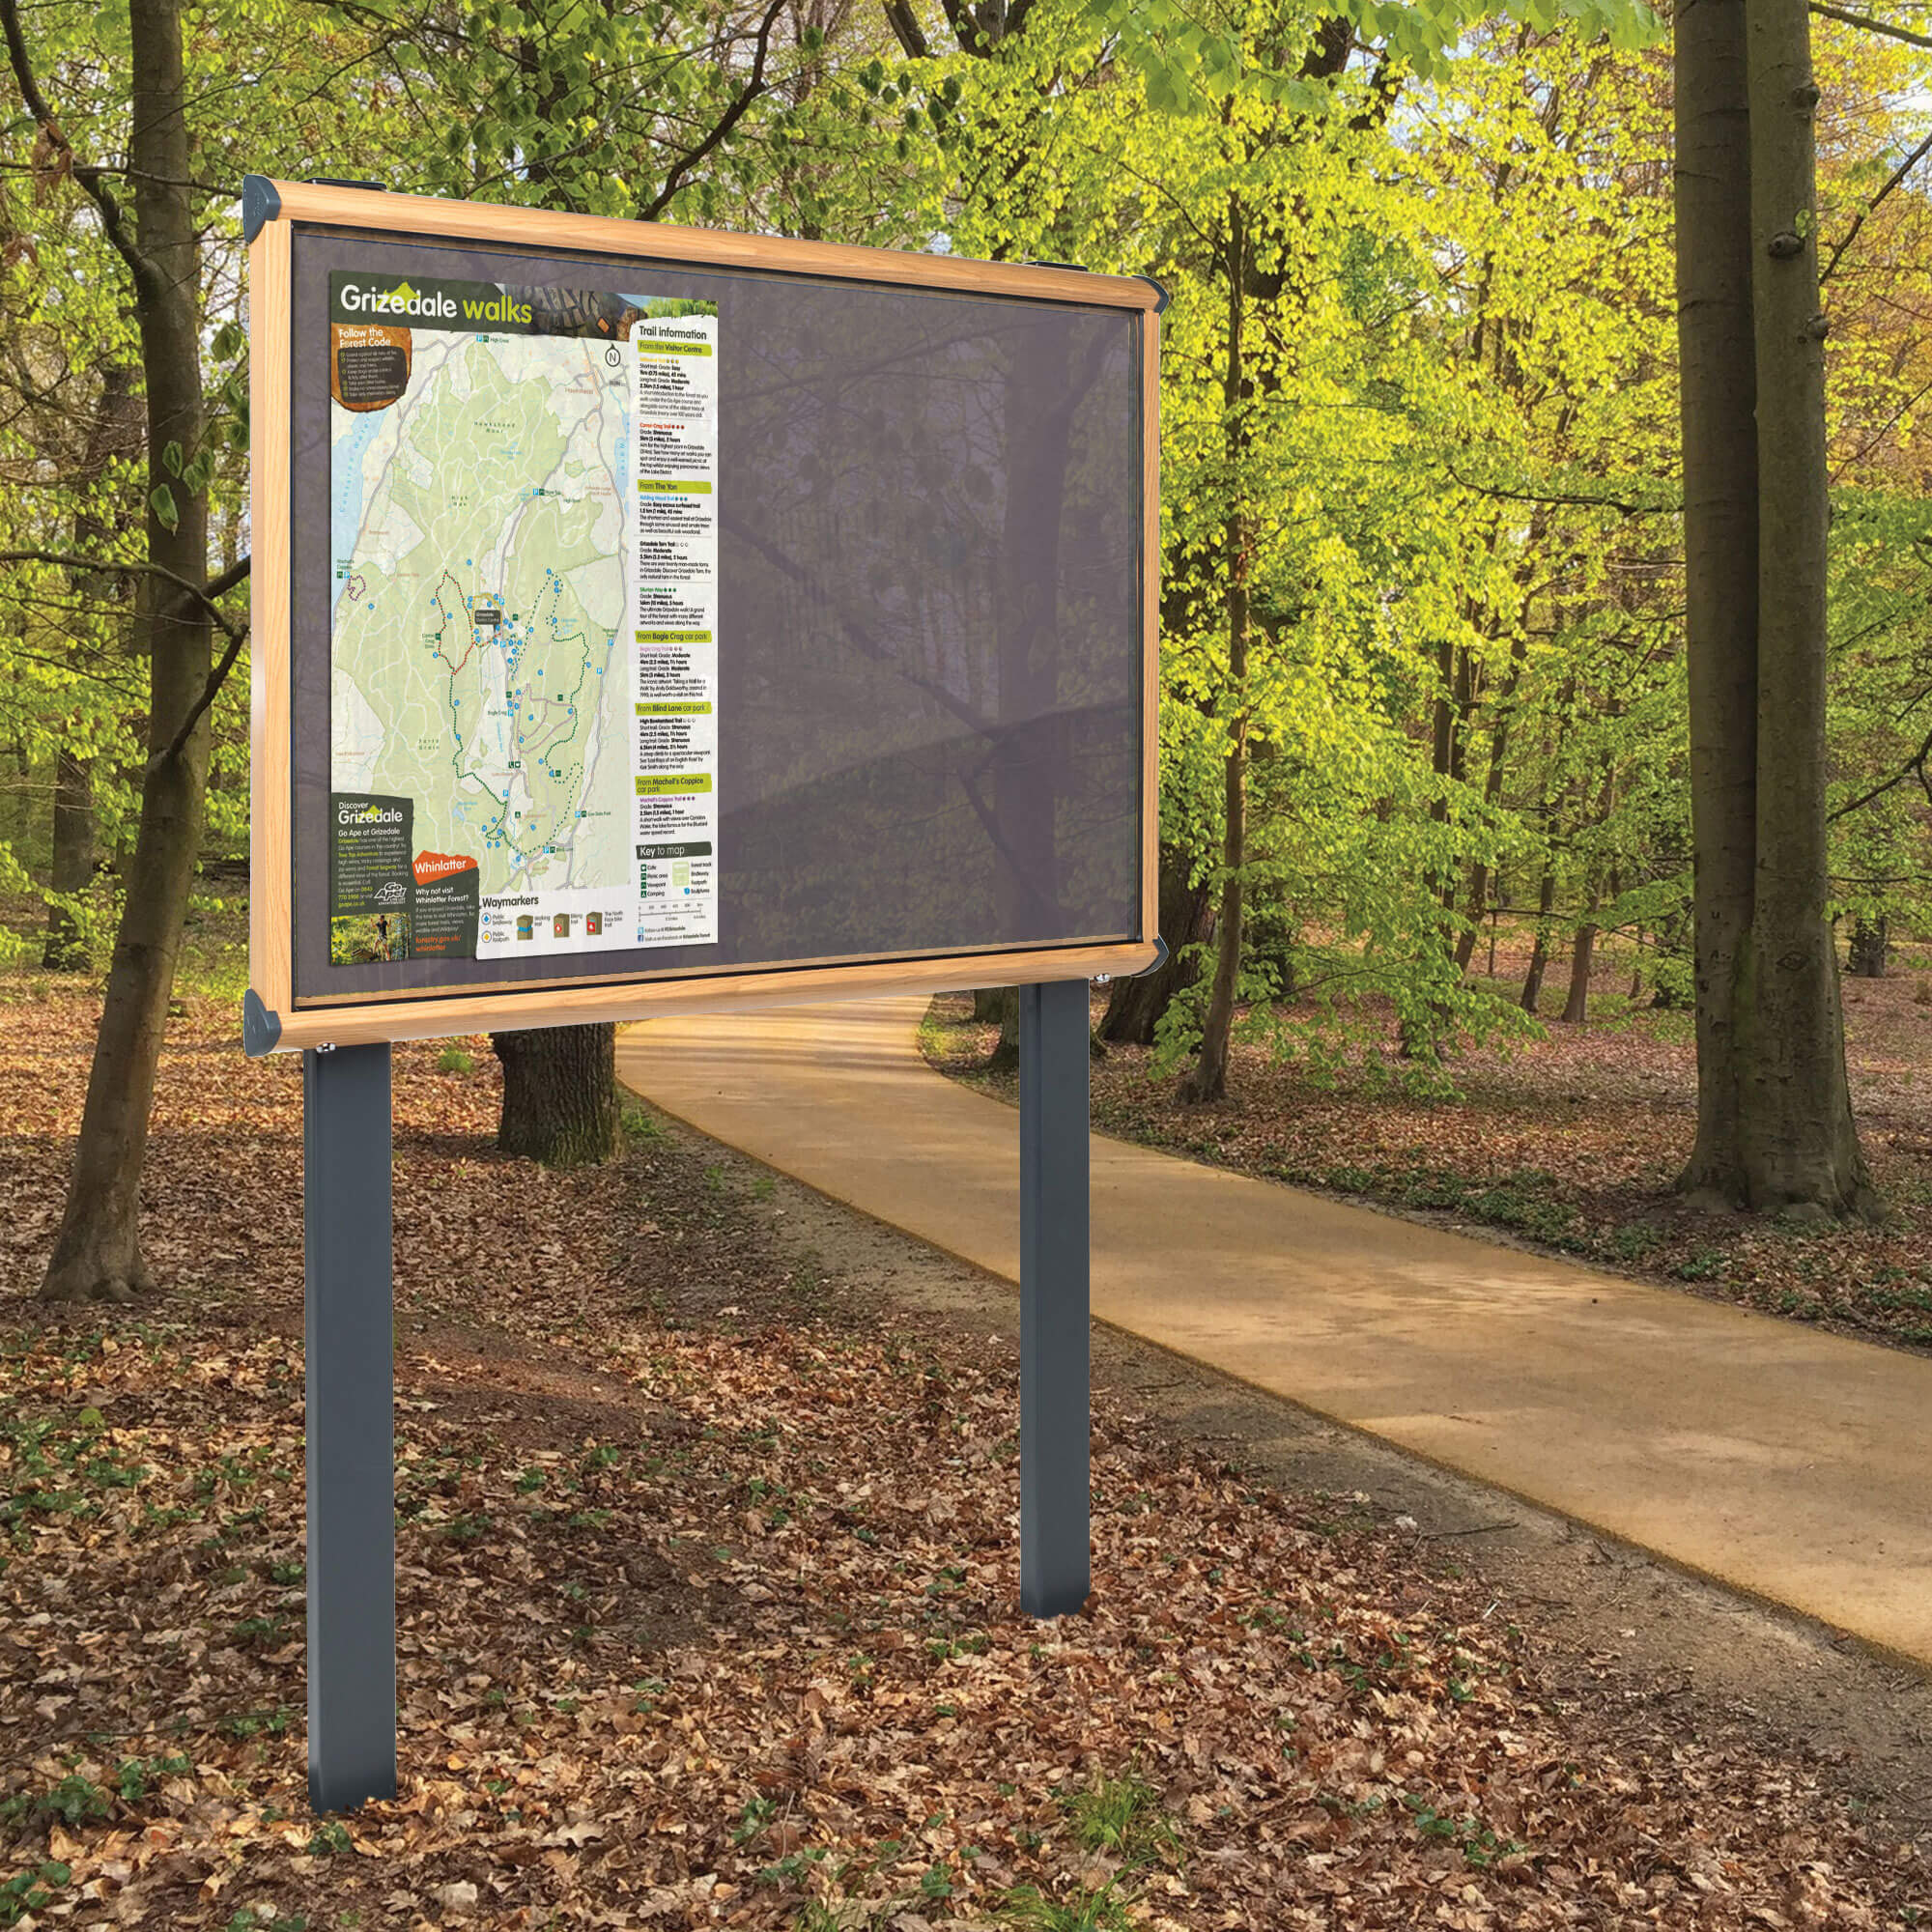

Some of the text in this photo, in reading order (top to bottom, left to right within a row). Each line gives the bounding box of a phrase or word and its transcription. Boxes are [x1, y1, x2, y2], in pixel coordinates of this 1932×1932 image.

[341, 284, 532, 324] Grizedale walks
[339, 328, 383, 339] Follow the
[639, 326, 707, 340] Trail information
[339, 338, 391, 348] Forest Code
[609, 352, 616, 362] N
[653, 633, 669, 641] Bogle
[670, 633, 684, 641] Crag
[681, 777, 704, 785] Coppice
[338, 808, 403, 824] Grizedale
[371, 827, 400, 835] Grizedale
[640, 846, 684, 857] Key to map
[415, 859, 466, 874] Whinlatter
[385, 882, 402, 890] Go
[482, 895, 539, 909] Waymarkers
